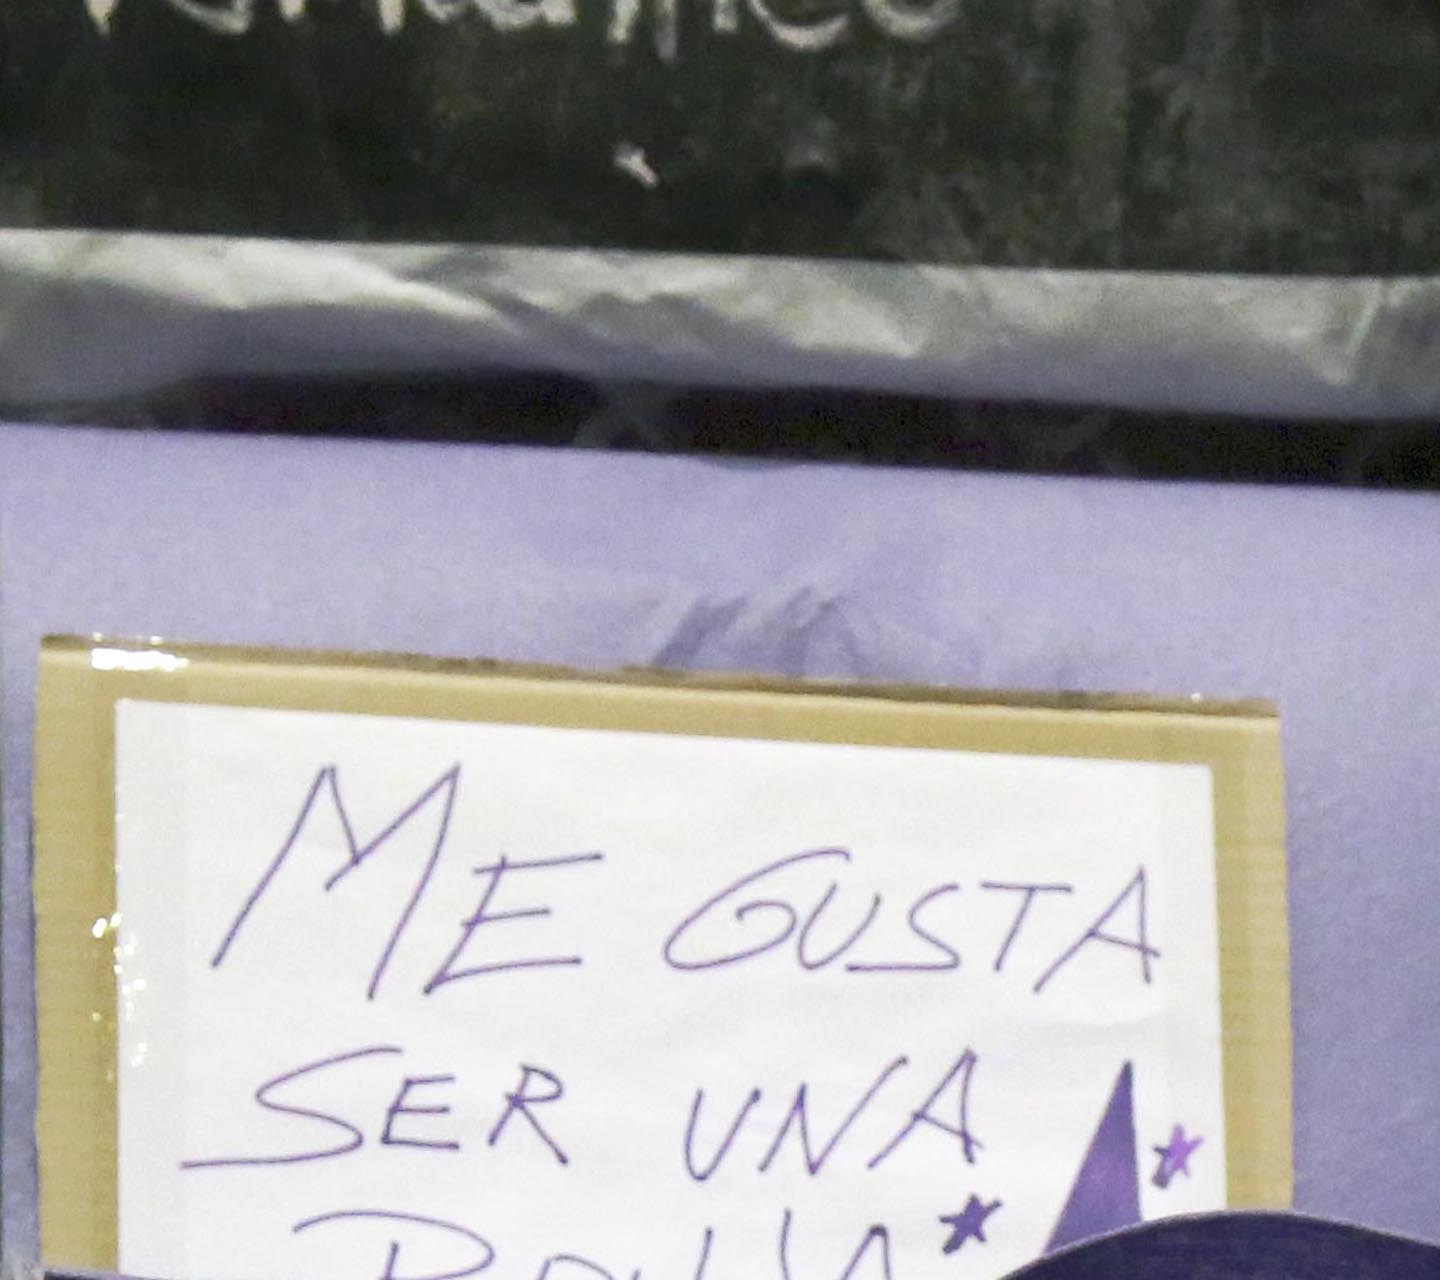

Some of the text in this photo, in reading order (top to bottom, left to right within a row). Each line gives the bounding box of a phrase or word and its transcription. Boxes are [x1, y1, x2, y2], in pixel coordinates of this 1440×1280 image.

[210, 762, 1162, 1001] ME GUSTA
[181, 1046, 987, 1183] SER UNA
